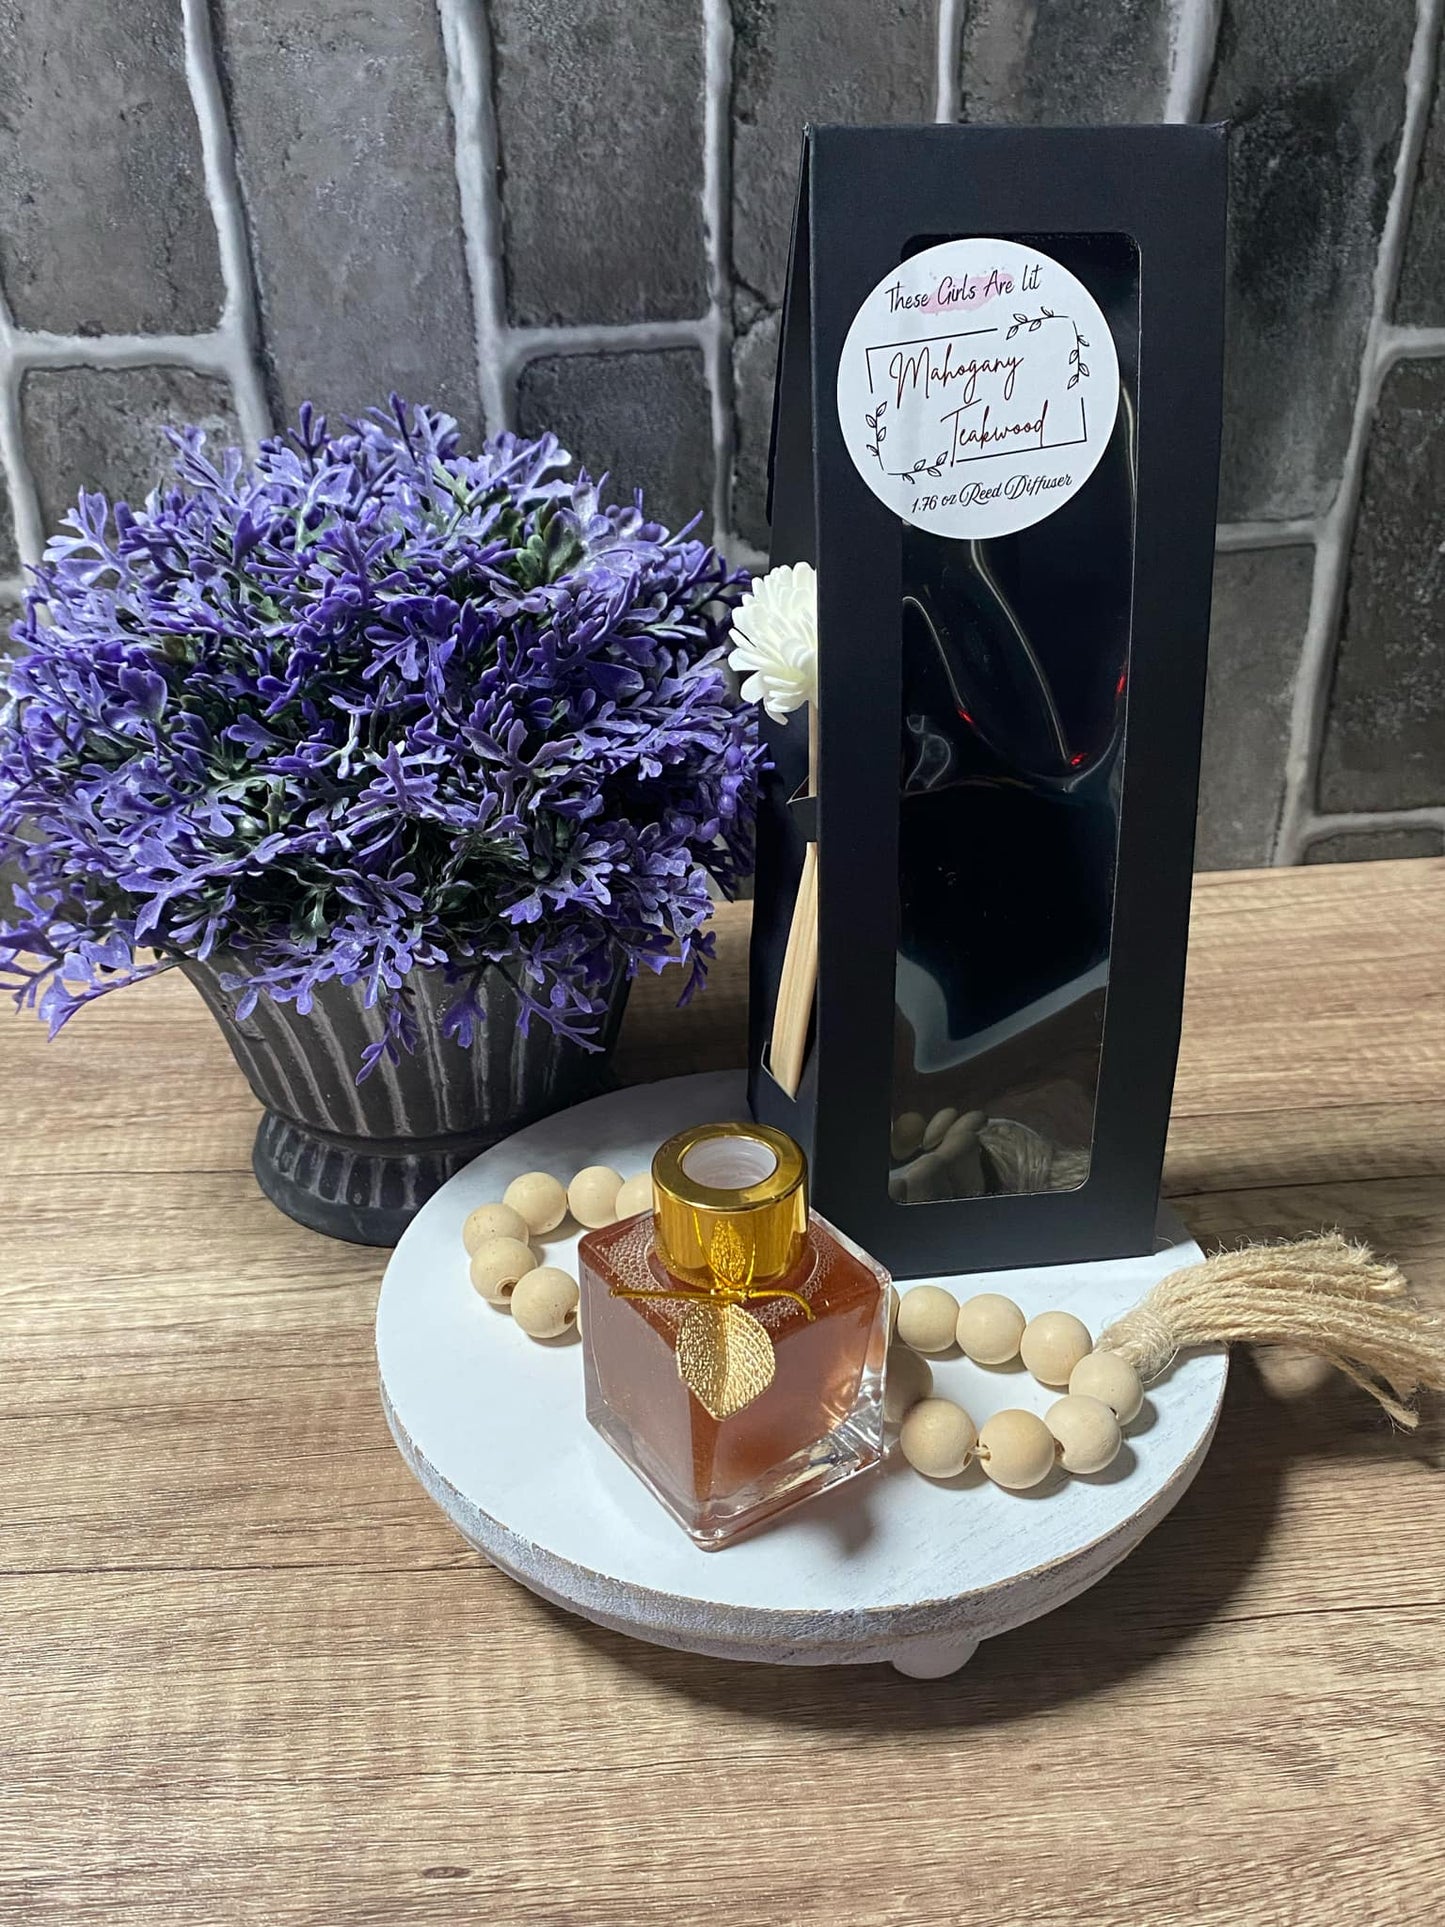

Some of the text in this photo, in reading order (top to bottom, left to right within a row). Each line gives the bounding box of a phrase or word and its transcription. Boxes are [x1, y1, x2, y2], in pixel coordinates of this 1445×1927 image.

[885, 281, 929, 313] These
[938, 274, 976, 305] Girls
[983, 269, 1014, 297] Are
[889, 343, 1024, 409] Mahogany
[940, 398, 1048, 467] Teakwood
[911, 473, 1072, 513] 1.76 oz Reed Diffuser
